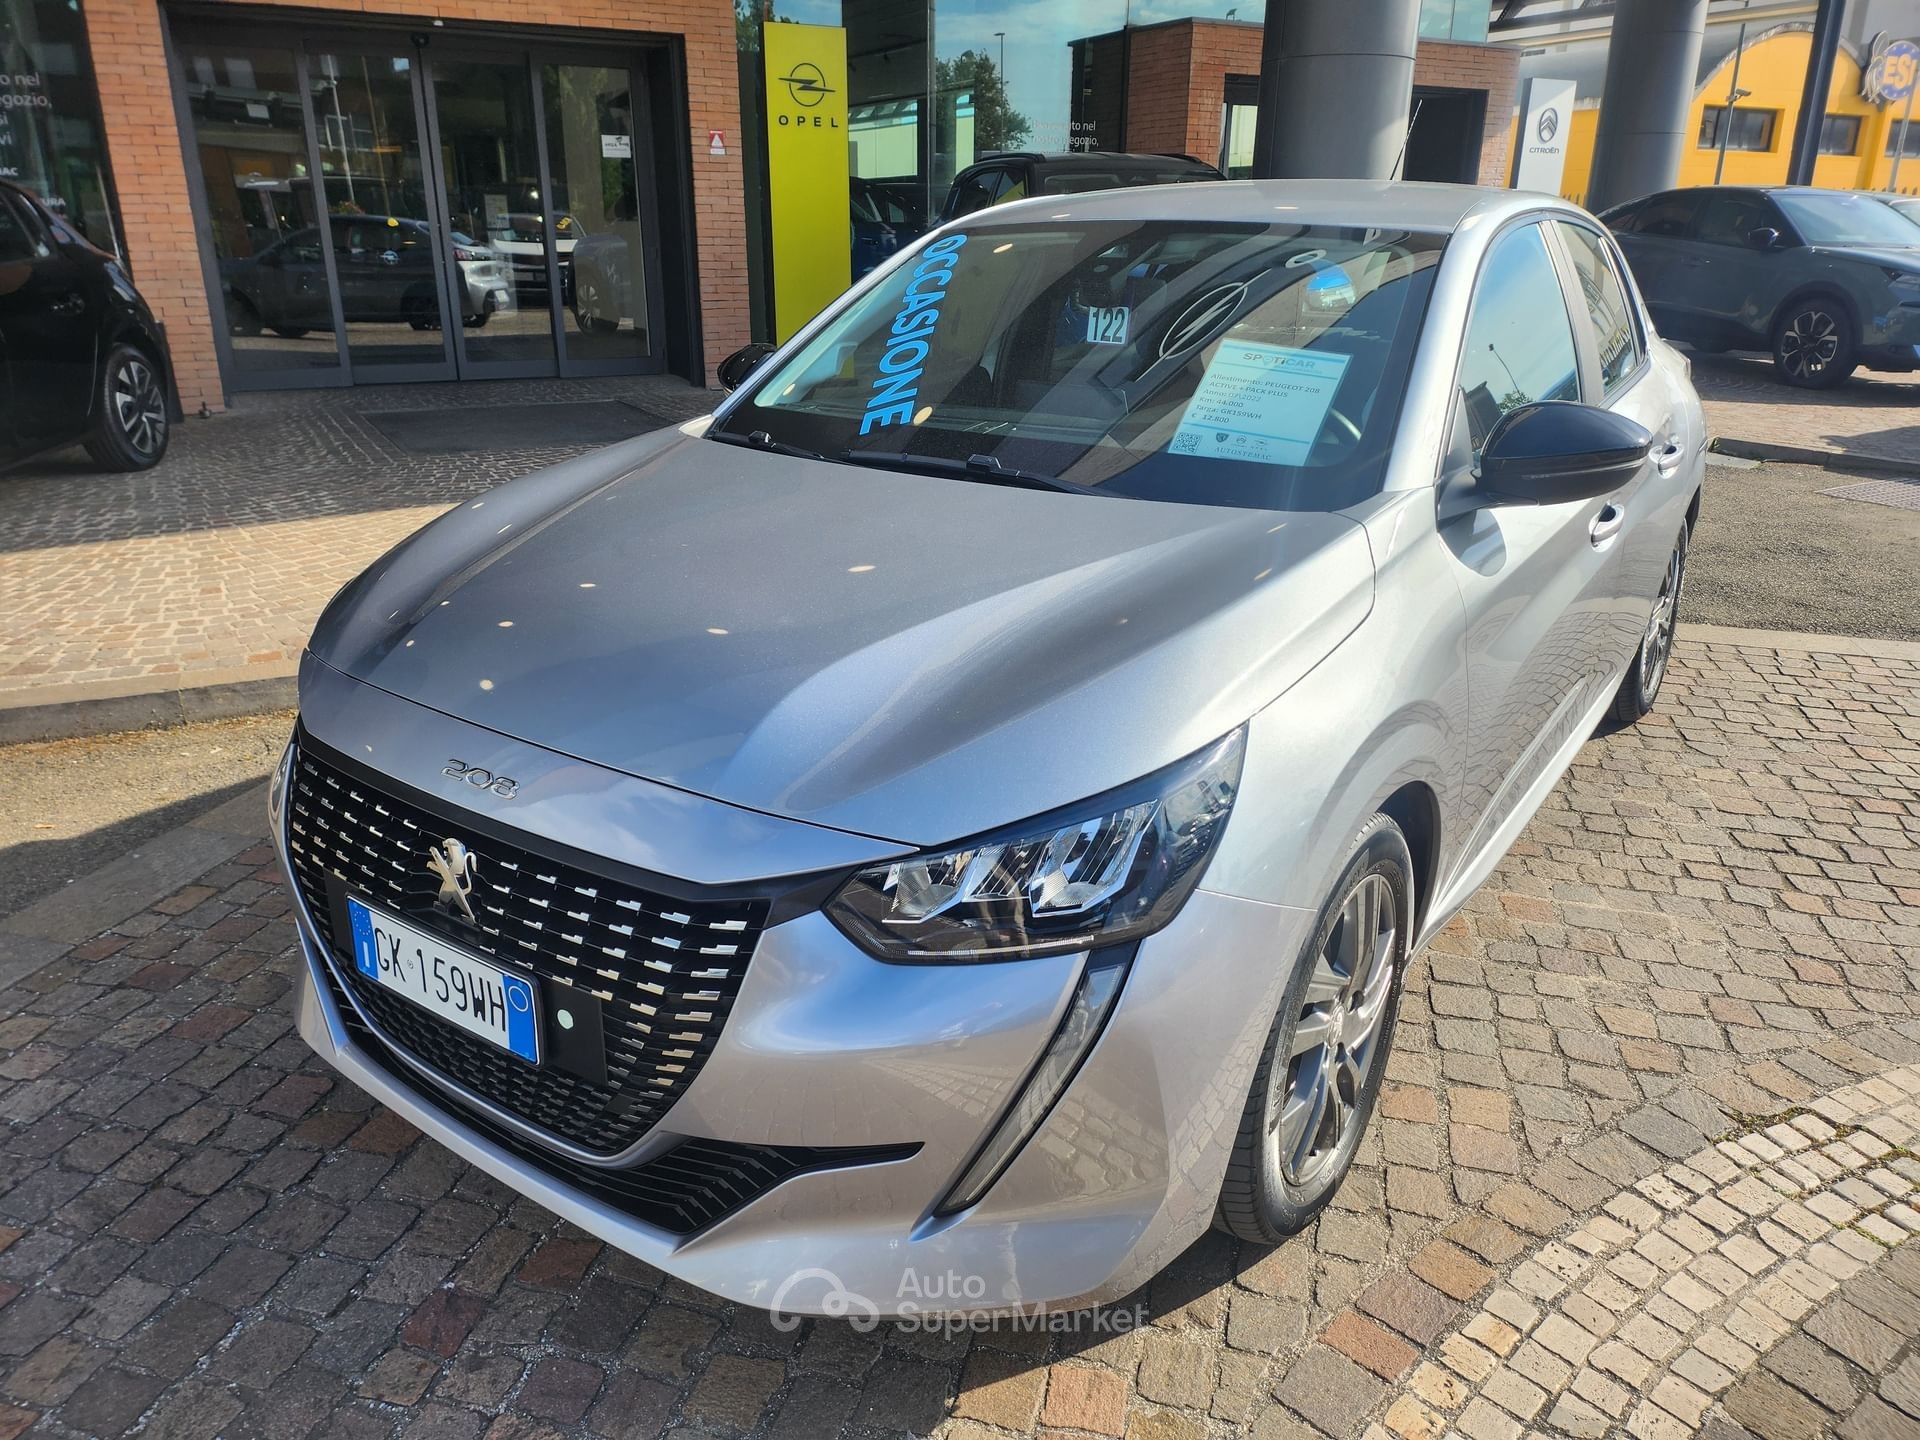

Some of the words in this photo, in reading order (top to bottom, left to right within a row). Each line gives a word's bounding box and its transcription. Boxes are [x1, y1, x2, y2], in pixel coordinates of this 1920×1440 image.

[15, 71, 40, 86] nel
[0, 92, 53, 109] gozio,
[778, 114, 839, 128] OPEL
[1083, 120, 1096, 131] nel
[1092, 307, 1126, 342] 122
[859, 234, 968, 436] OCCASIONE
[1203, 388, 1228, 397] Anno:
[1208, 381, 1238, 390] ACTIVE
[1245, 386, 1267, 395] PACK
[1267, 390, 1289, 398] PLUS
[1264, 380, 1304, 391] PEUGEOT
[1304, 386, 1321, 394] 208
[1216, 399, 1244, 408] 44.000
[1196, 404, 1219, 413] Targa:
[1220, 408, 1262, 420] GK159WH
[1202, 414, 1230, 424] 12.800
[441, 758, 520, 801] 208
[374, 927, 407, 984] GK
